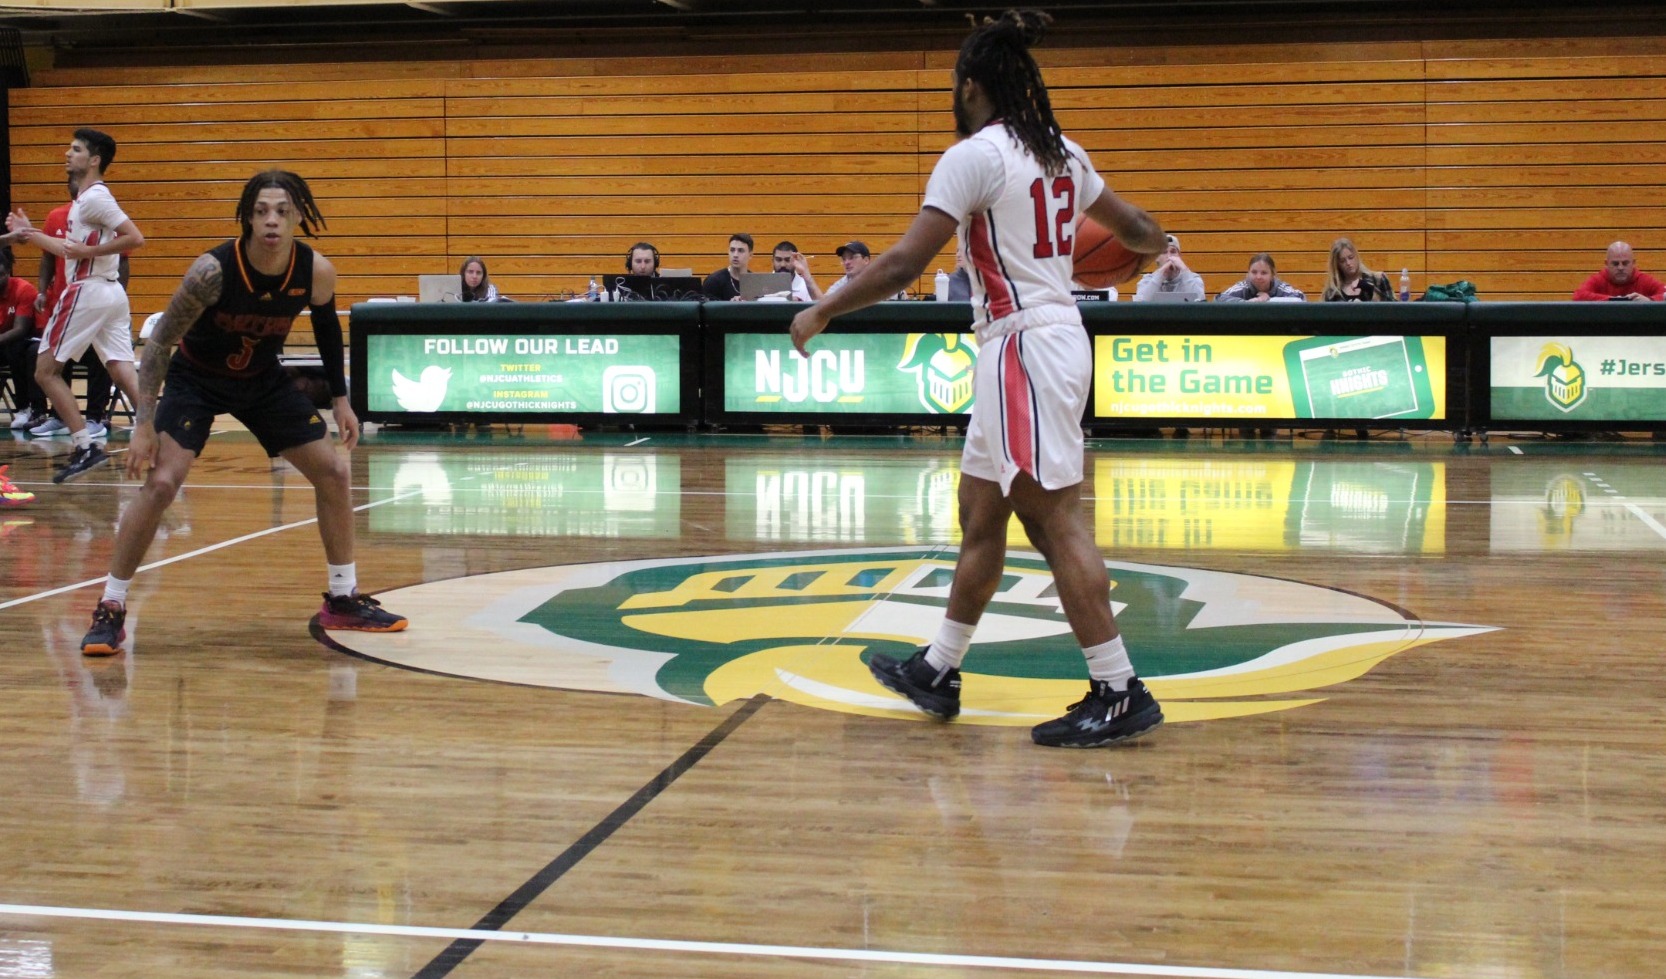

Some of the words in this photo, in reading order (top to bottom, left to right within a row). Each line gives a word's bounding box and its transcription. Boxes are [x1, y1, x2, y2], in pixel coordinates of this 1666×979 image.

[1029, 175, 1076, 260] 12
[424, 338, 509, 355] FOLLOW
[514, 338, 558, 355] OUR
[565, 338, 619, 355] LEAD
[1111, 338, 1170, 363] Get
[1181, 338, 1212, 363] in
[501, 363, 541, 372] TWITTER
[480, 374, 563, 383] @NJCUATHLETICS
[755, 349, 865, 403] NJCU
[1112, 369, 1167, 394] the
[1179, 370, 1273, 395] Game
[493, 390, 549, 399] INSTAGRAM
[466, 401, 577, 410] @NJCUGOTHICKNIGHTS
[1110, 401, 1267, 415] njcugothicknights.com
